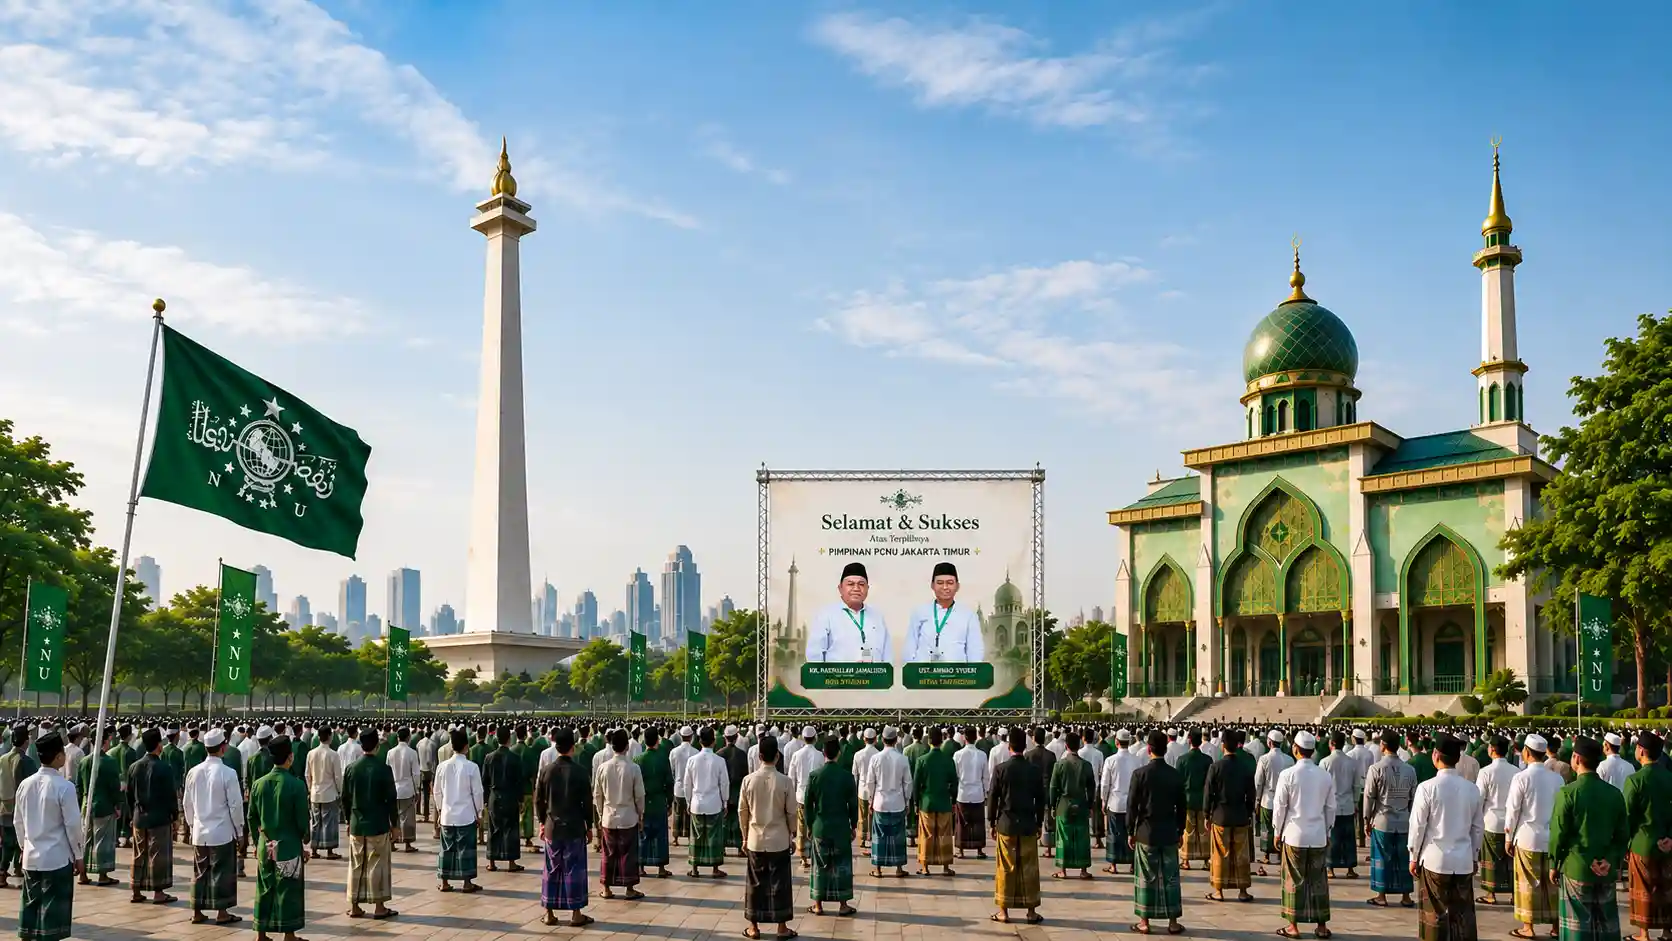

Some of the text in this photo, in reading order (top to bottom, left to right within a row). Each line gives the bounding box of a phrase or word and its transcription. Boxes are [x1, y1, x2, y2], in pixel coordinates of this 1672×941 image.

[821, 514, 979, 530] Selamat & Sukses
[869, 534, 887, 543] Atas
[828, 548, 970, 556] PIMPINAN PCNU JAKARTA TIMUR
